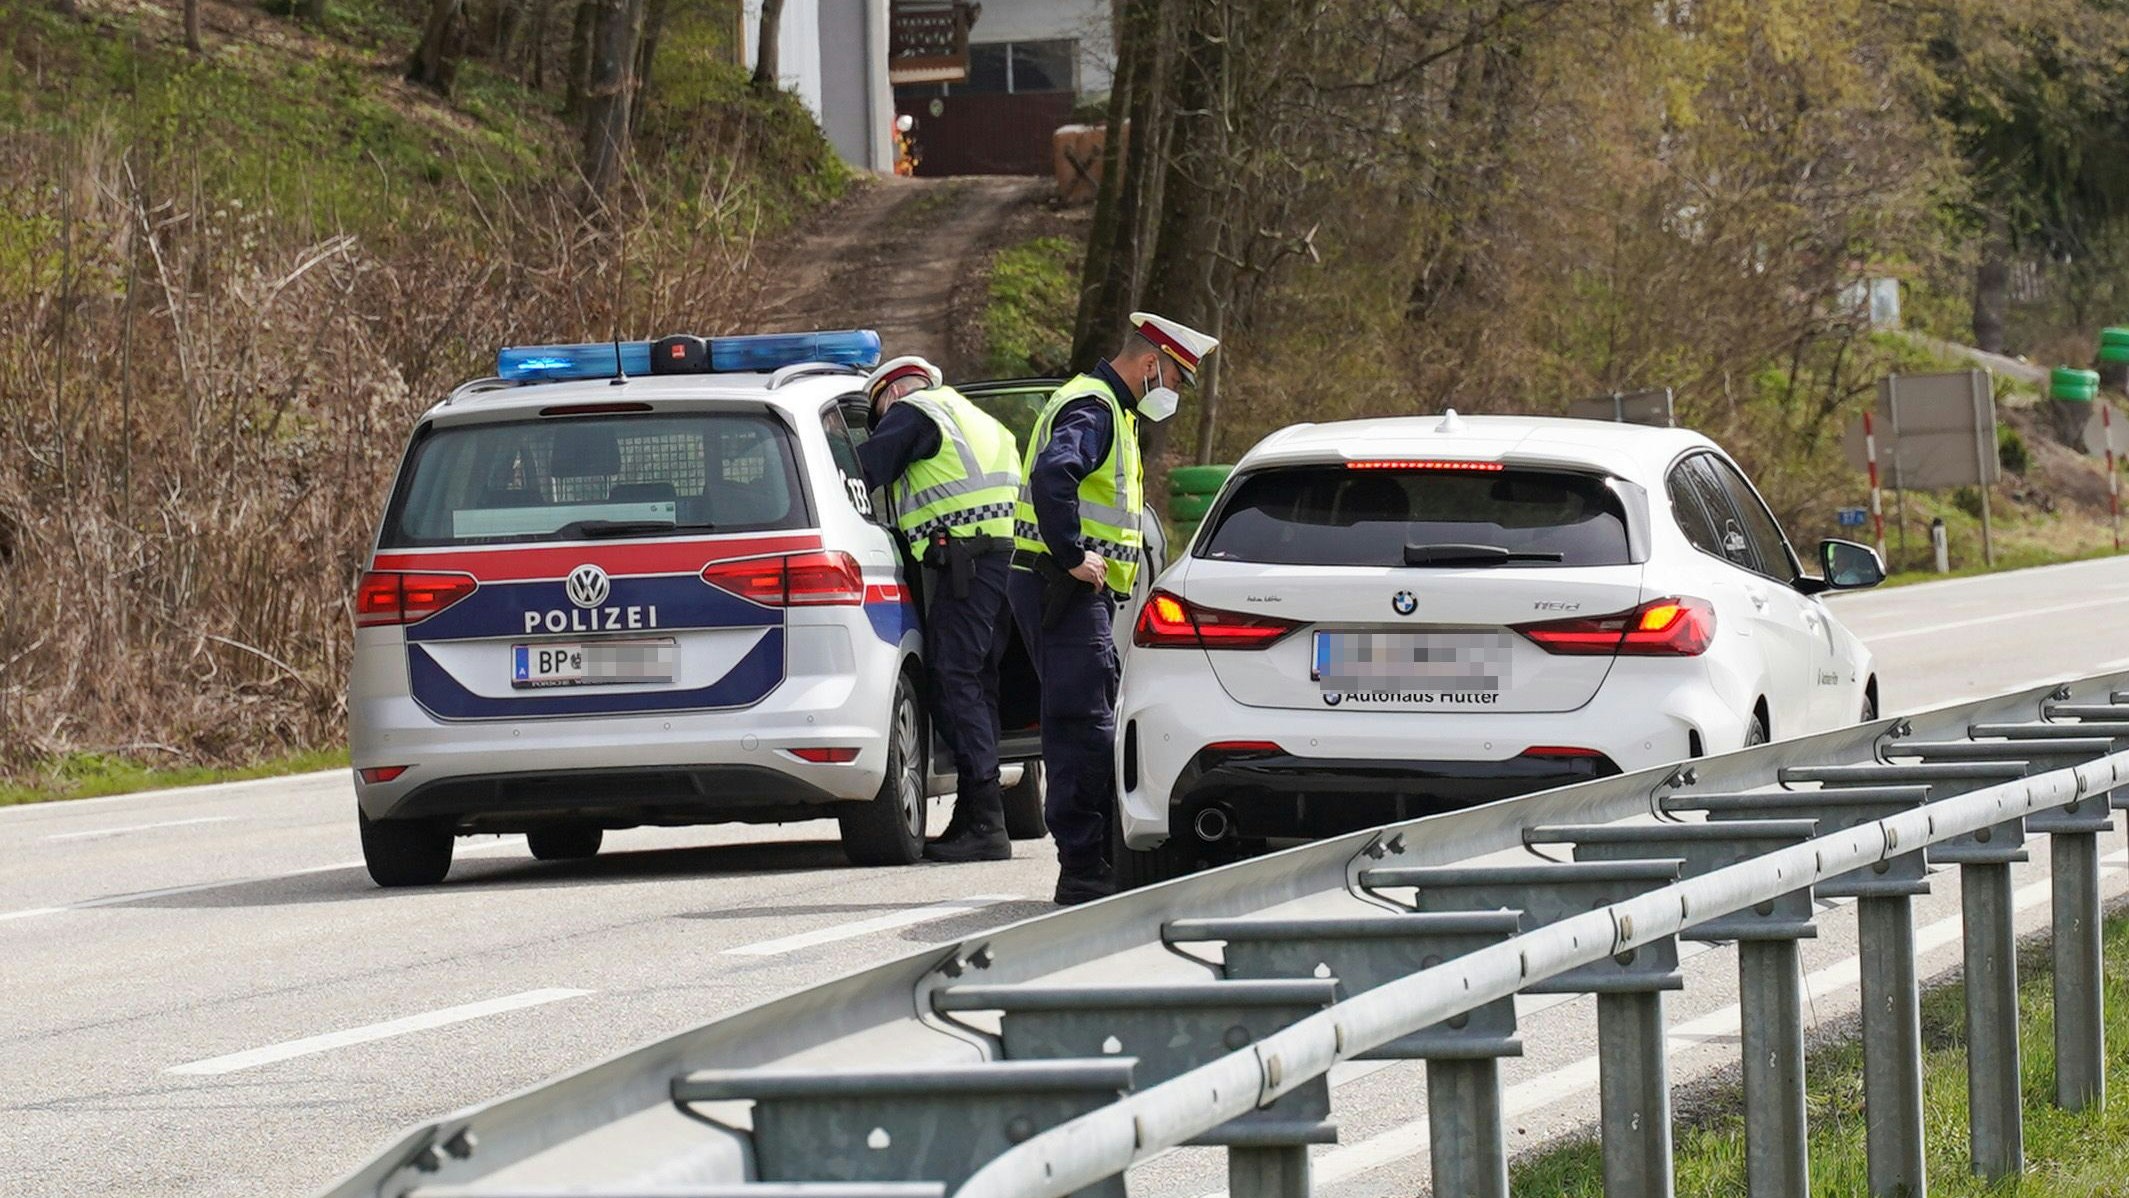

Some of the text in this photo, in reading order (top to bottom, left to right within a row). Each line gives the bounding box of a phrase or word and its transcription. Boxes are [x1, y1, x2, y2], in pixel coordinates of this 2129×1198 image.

[524, 605, 657, 633] POLIZEI
[539, 650, 568, 674] BP
[1345, 693, 1434, 704] Autohaus
